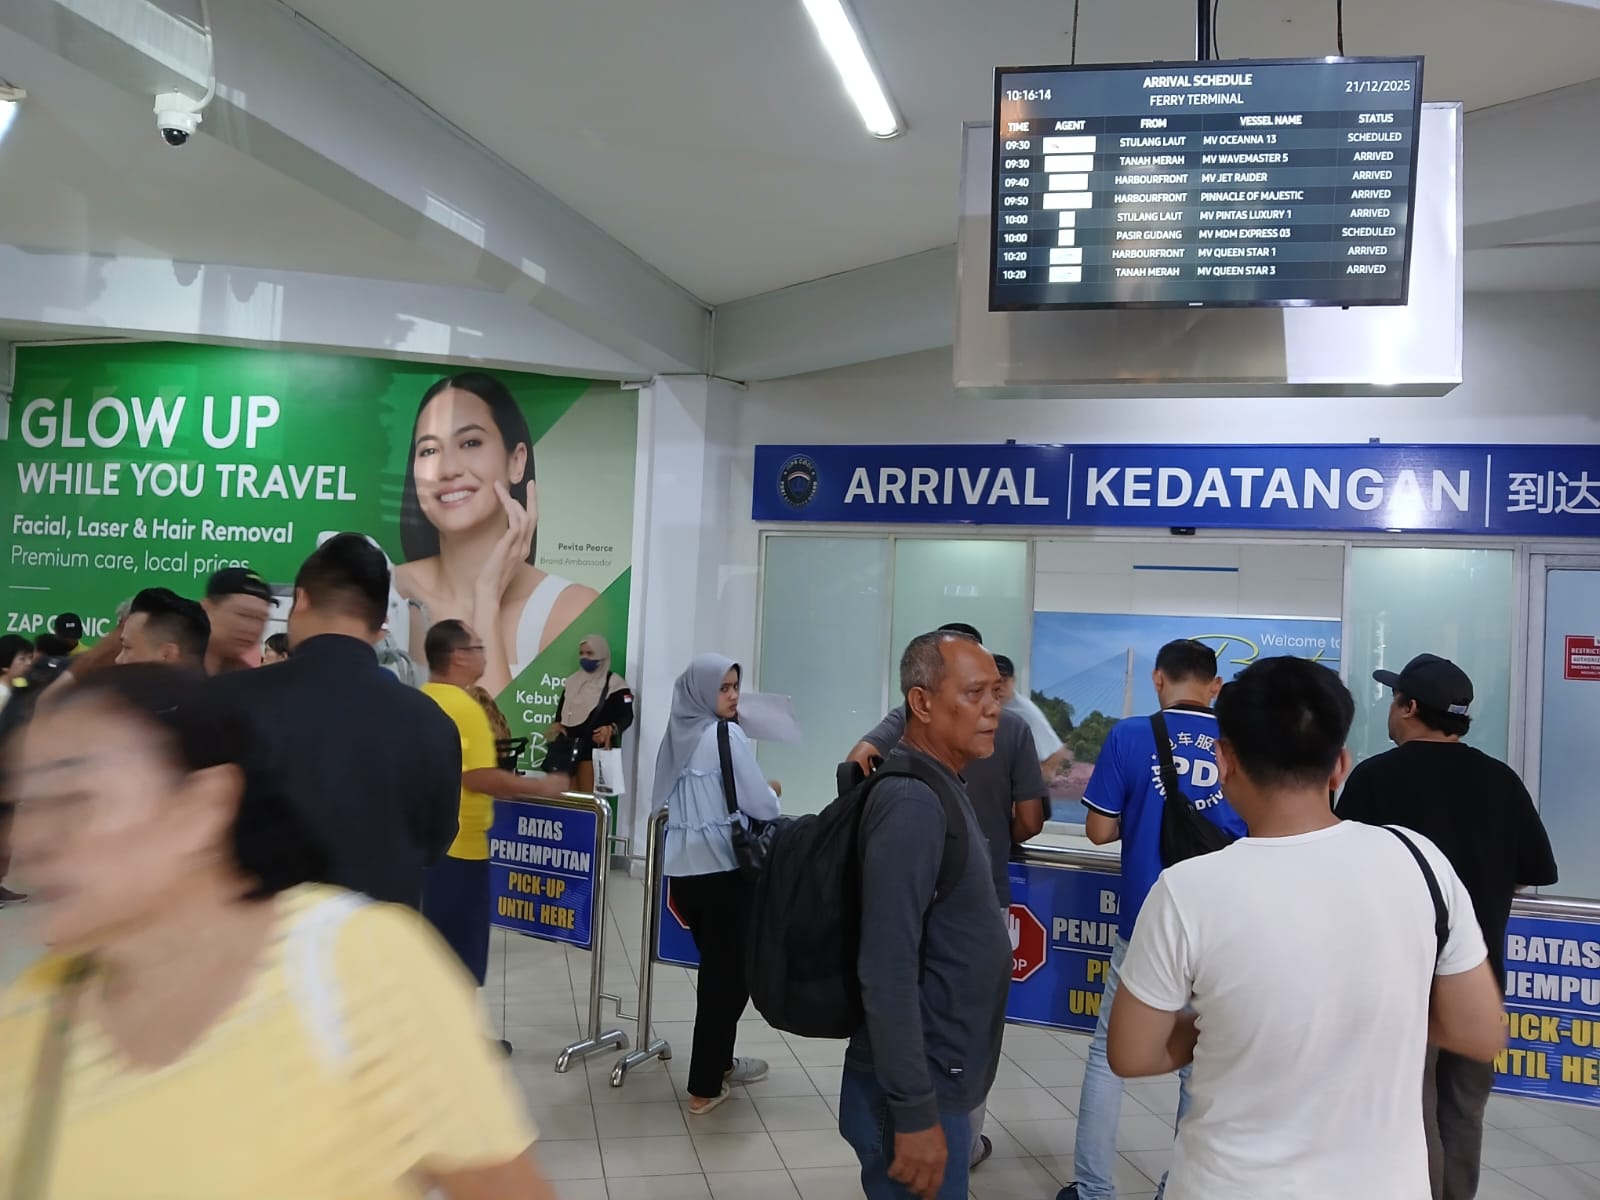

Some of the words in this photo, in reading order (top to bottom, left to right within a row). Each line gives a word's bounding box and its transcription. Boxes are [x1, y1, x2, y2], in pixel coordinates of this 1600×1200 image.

[1143, 75, 1191, 89] ARRIVAL
[1193, 73, 1253, 87] SCHEDULE
[1346, 79, 1411, 93] 21/12/2025
[1006, 89, 1052, 101] 10:16:14
[1150, 94, 1185, 107] FERRY
[1188, 92, 1244, 106] TERMINAL
[1007, 121, 1030, 133] TIME
[1054, 120, 1086, 131] AGENT
[1140, 117, 1168, 129] FROM
[1239, 115, 1273, 126] VESSEL
[1274, 114, 1303, 126] NAME
[1358, 113, 1394, 124] STATUS
[1005, 140, 1030, 151] 09:30
[1119, 137, 1161, 148] STULANG
[1162, 136, 1187, 147] LAUT
[1203, 135, 1218, 145] MV
[1219, 134, 1264, 145] OCEANNA
[1266, 134, 1277, 144] 13
[1347, 132, 1402, 143] SCHEDULED
[1005, 158, 1030, 170] 09:30
[1120, 156, 1151, 166] TANAH
[1152, 155, 1185, 165] MERAH
[1202, 154, 1218, 164] MV
[1218, 153, 1281, 164] WAVEMASTER
[1282, 153, 1289, 163] 5
[1353, 151, 1394, 162] ARRIVED
[1004, 177, 1029, 188] 09:40
[1115, 173, 1189, 185] HARBOURFRONT
[1201, 174, 1216, 184] MV
[1217, 173, 1233, 184] JET
[1234, 172, 1268, 183] RAIDER
[1352, 170, 1393, 181] ARRIVED
[1004, 195, 1029, 206] 09:50
[1114, 192, 1188, 204] HARBOURFRONT
[1200, 191, 1246, 202] PINNACLE
[1246, 191, 1261, 201] OF
[1262, 190, 1305, 201] MAJESTIC
[1351, 189, 1392, 200] ARRIVED
[1004, 214, 1028, 225] 10:00
[1117, 212, 1158, 222] STULANG
[1159, 211, 1184, 221] LAUT
[1199, 211, 1215, 221] MV
[1215, 210, 1248, 220] PINTAS
[1249, 210, 1285, 220] LUXURY
[1286, 209, 1292, 219] 1
[1350, 208, 1390, 219] ARRIVED
[1003, 233, 1028, 243] 10:00
[1116, 230, 1143, 241] PASIR
[1143, 230, 1183, 240] GUDANG
[1198, 229, 1214, 239] MV
[1214, 229, 1238, 239] MDM
[1238, 228, 1278, 238] EXPRESS
[1279, 228, 1291, 238] 03
[1341, 227, 1396, 237] SCHEDULED
[1003, 251, 1027, 262] 10:20
[1112, 248, 1185, 260] HARBOURFRONT
[1198, 248, 1213, 258] MV
[1213, 247, 1246, 258] QUEEN
[1246, 247, 1270, 257] STAR
[1271, 247, 1277, 257] 1
[1347, 245, 1388, 256] ARRIVED
[1002, 269, 1027, 280] 10:20
[1115, 267, 1147, 278] TANAH
[1147, 266, 1180, 277] MERAH
[1197, 266, 1212, 276] MV
[1213, 266, 1244, 277] QUEEN
[1245, 266, 1269, 276] STAR
[1269, 266, 1276, 275] 3
[1346, 264, 1387, 275] ARRIVED
[21, 396, 187, 449] GLOW
[202, 395, 281, 449] UP
[17, 462, 121, 496] WHILE
[130, 462, 205, 498] YOU
[215, 463, 357, 501] TRAVEL
[843, 467, 1049, 506] ARRIVAL
[1085, 467, 1470, 512] KEDATANGAN
[1507, 470, 1600, 514] 到达
[13, 514, 72, 540] Facial,
[78, 515, 129, 539] Laser
[132, 517, 148, 539] &
[152, 517, 196, 541] Hair
[201, 519, 294, 544] Removal
[558, 542, 584, 551] Pevita
[585, 543, 613, 552] Pearce
[11, 544, 89, 568] Premium
[94, 552, 139, 575] care,
[144, 550, 188, 573] local
[6, 612, 44, 633] ZAP
[46, 614, 111, 637] CNIC
[1260, 633, 1326, 648] Welcome
[516, 690, 561, 706] Kebut
[1168, 731, 1217, 760] 车服
[1151, 765, 1168, 800] Priv
[1194, 788, 1225, 811] Driv
[518, 815, 563, 841] BATAS
[490, 838, 591, 873] PENJEMPUTAN
[508, 871, 566, 899] PICK-UP
[497, 895, 535, 922] UNTIL
[540, 903, 575, 929] HERE
[1507, 933, 1600, 969] BATAS
[1504, 970, 1600, 1006] JEMPU
[1493, 1047, 1550, 1080] NTIL
[1562, 1055, 1600, 1086] HE
